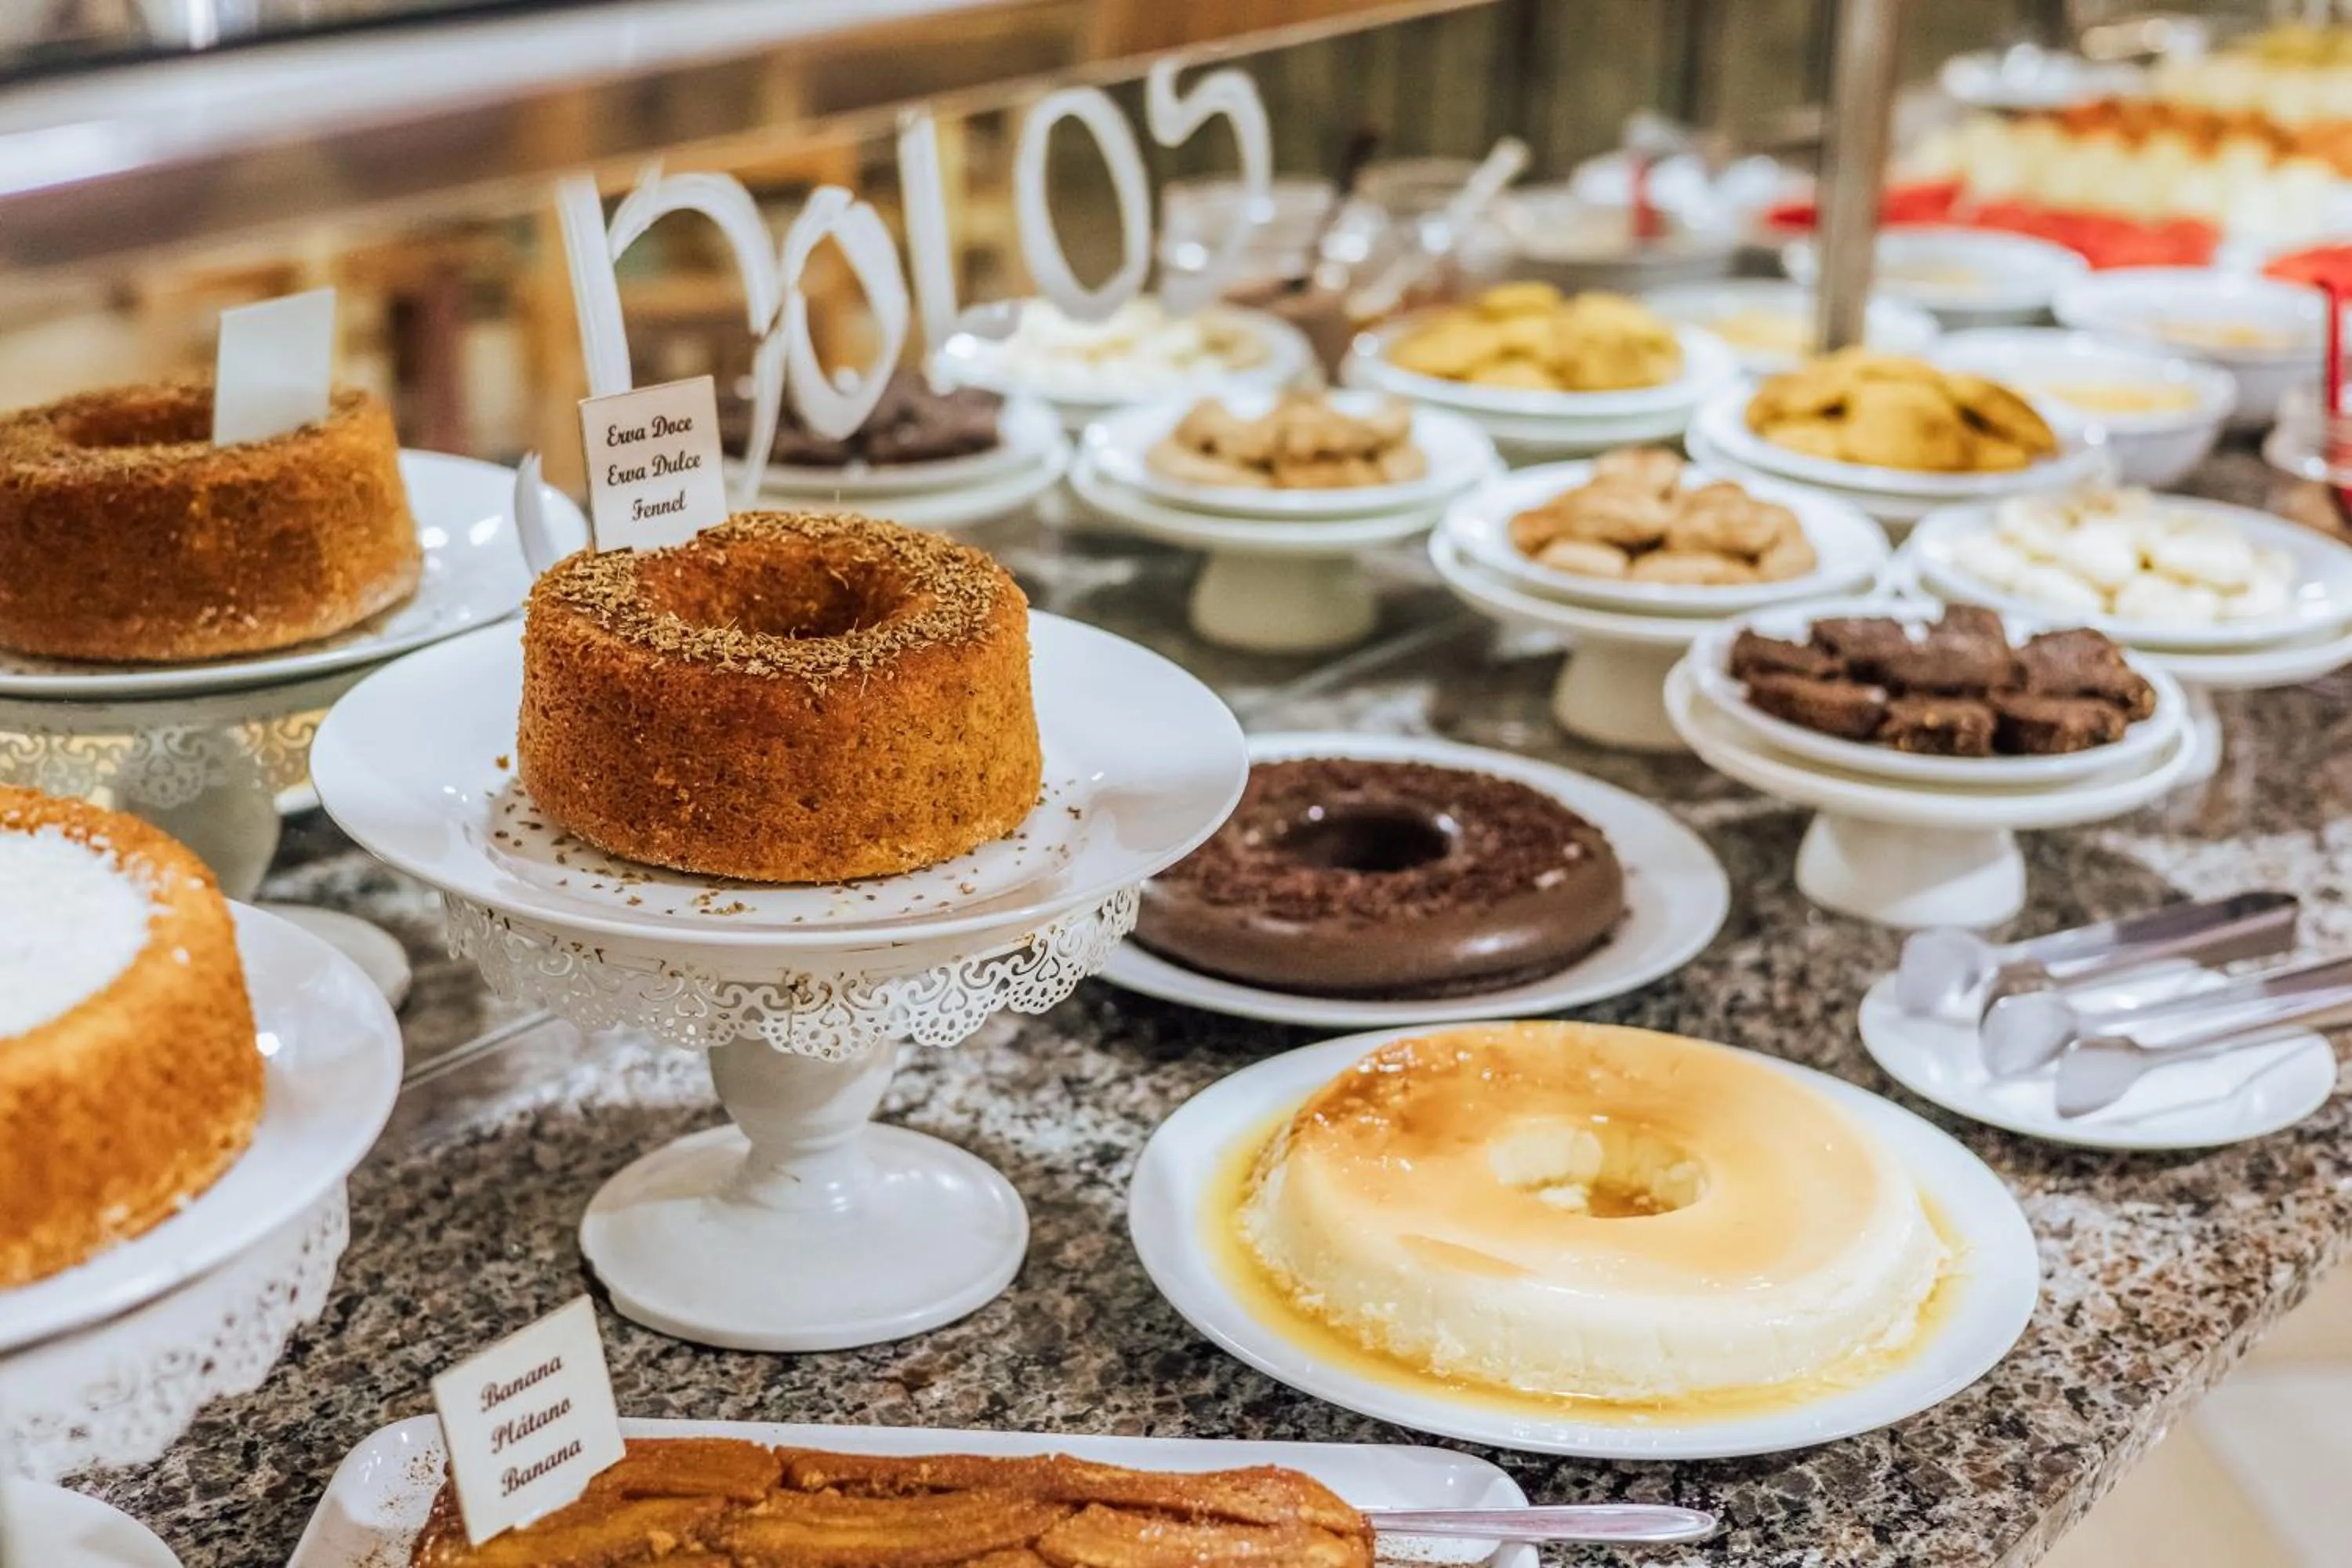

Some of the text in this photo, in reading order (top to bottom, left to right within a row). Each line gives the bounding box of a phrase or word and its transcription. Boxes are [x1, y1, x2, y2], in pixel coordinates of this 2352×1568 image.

[606, 415, 693, 447] Erva Doce
[607, 450, 701, 486] Erva Dulce
[632, 489, 687, 521] Fennel
[480, 1355, 563, 1412] Banana
[491, 1397, 572, 1454] Plátano
[501, 1439, 583, 1497] Banana
